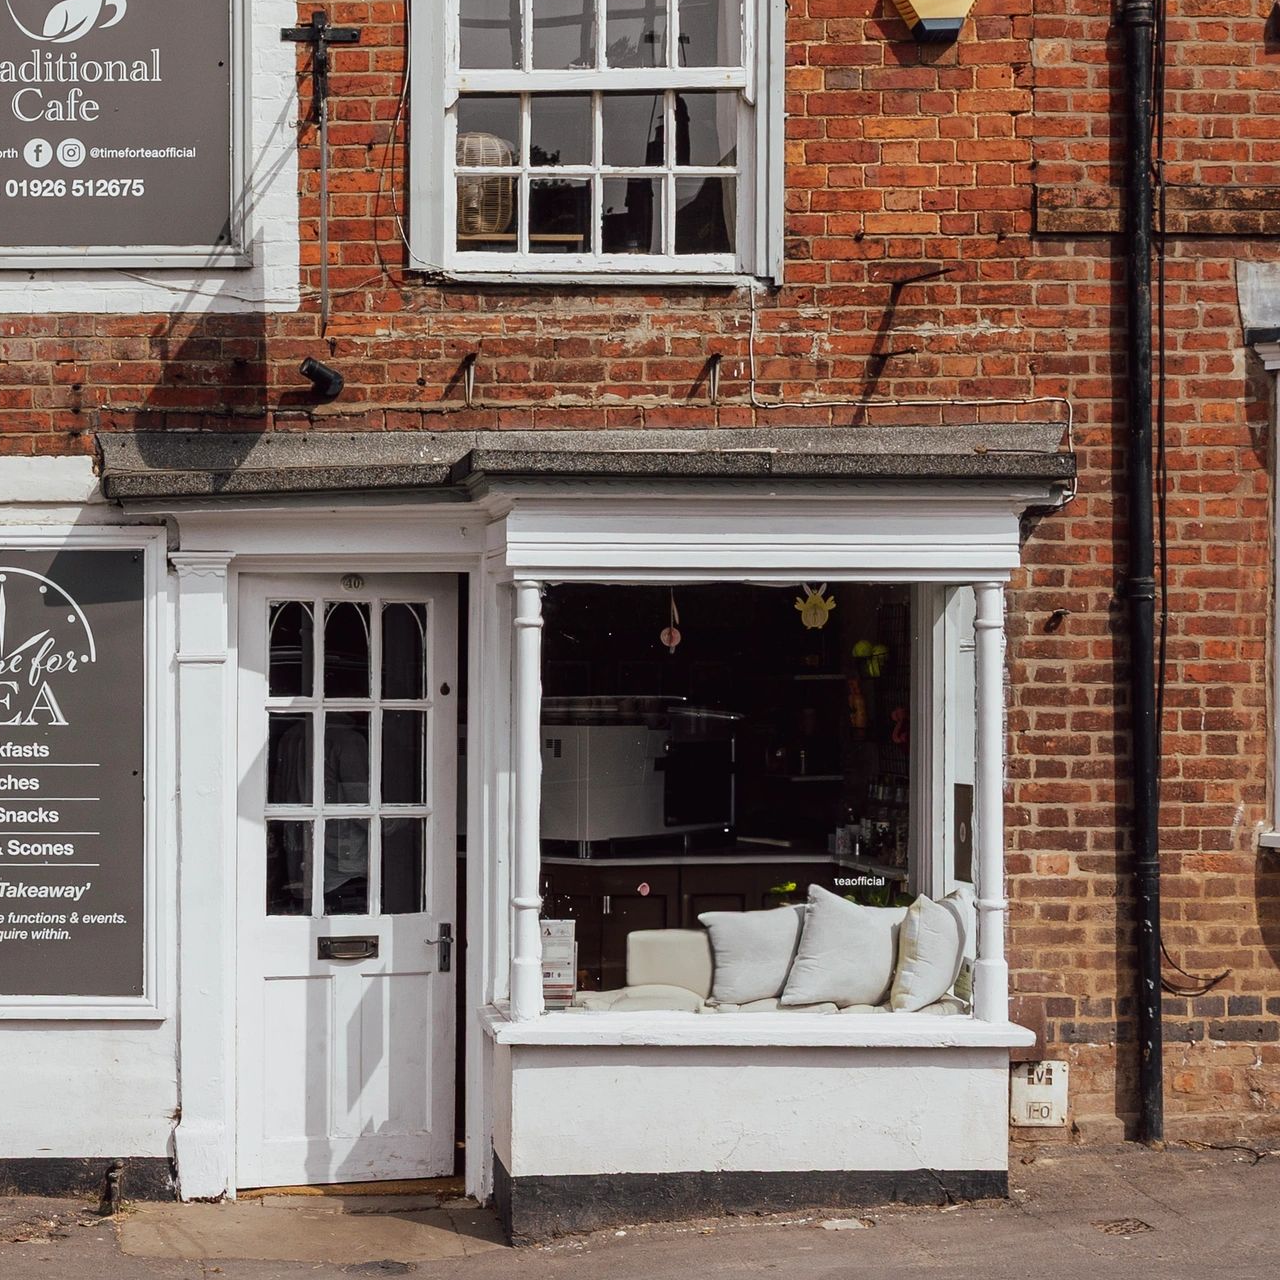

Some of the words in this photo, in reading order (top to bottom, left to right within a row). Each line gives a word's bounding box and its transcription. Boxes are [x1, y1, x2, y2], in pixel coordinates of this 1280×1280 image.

[11, 87, 100, 122] Cafe
[89, 147, 196, 159] @timeforteaofficial
[5, 179, 66, 197] 01926
[71, 179, 145, 197] 512675
[343, 578, 360, 588] 40
[28, 637, 78, 687] for
[7, 839, 74, 856] Scones
[7, 911, 67, 924] functions
[69, 912, 79, 924] &
[82, 912, 127, 924] events.
[31, 927, 72, 940] within.
